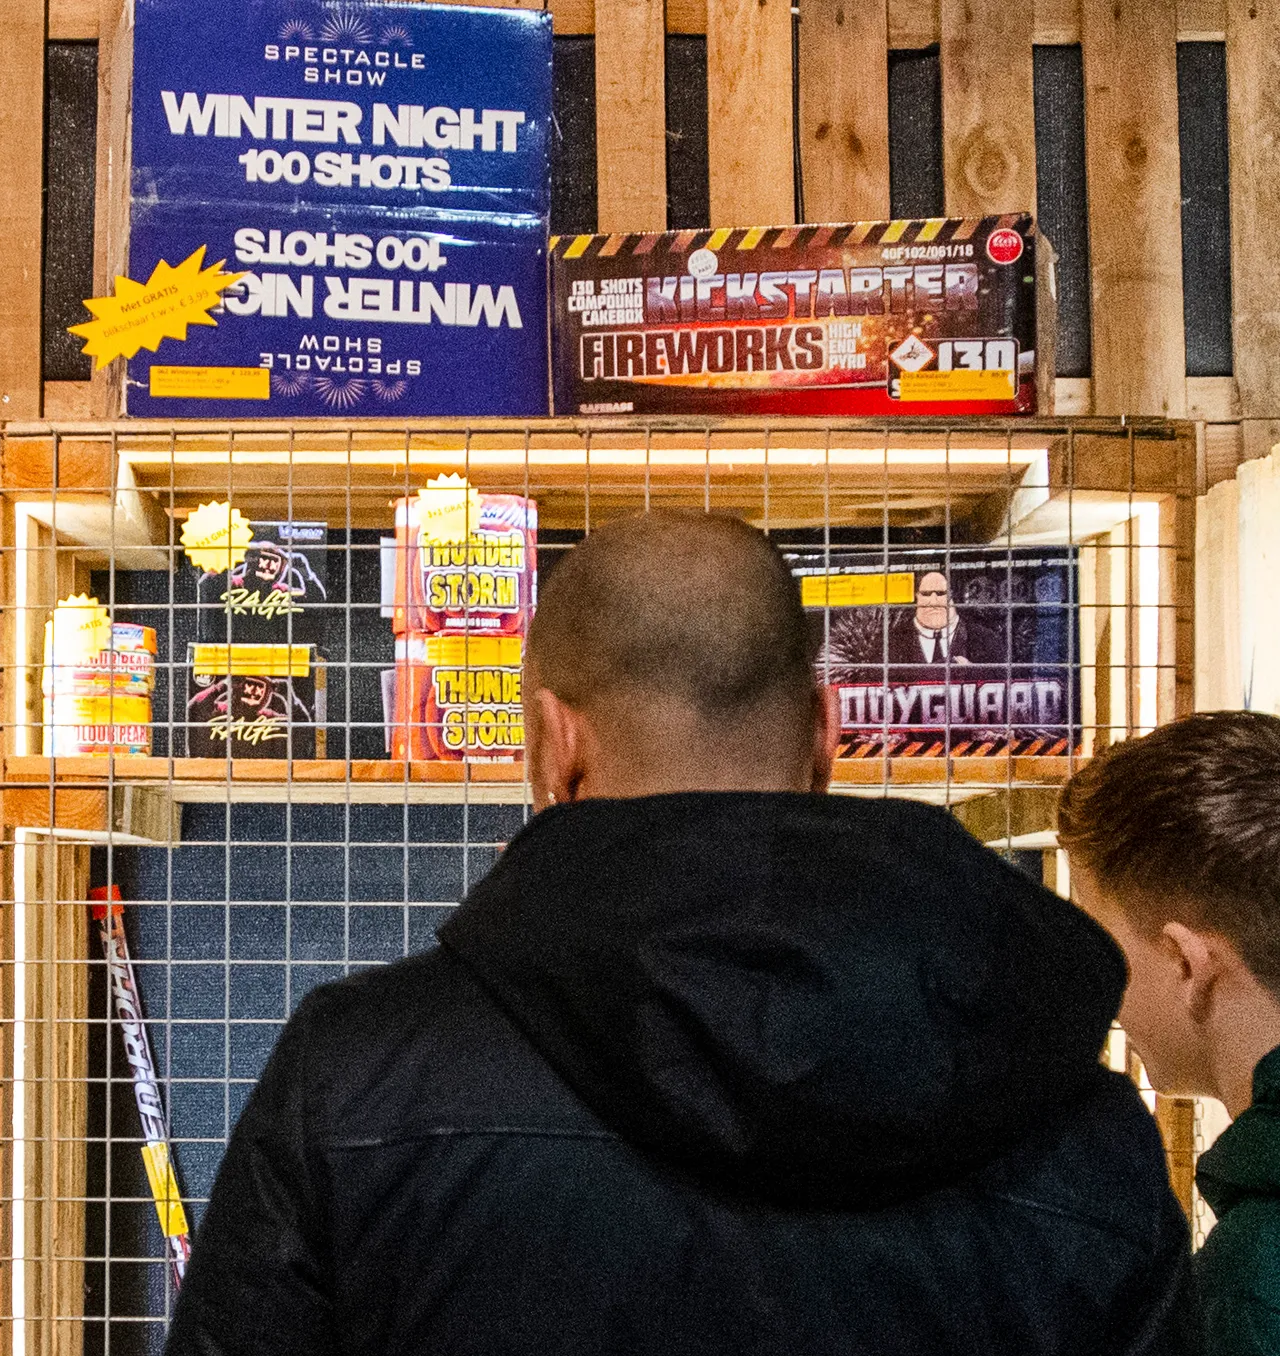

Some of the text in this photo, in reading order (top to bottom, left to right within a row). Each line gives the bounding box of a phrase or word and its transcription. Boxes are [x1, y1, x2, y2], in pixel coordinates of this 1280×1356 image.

[264, 45, 426, 69] SPECTACLE
[304, 67, 387, 86] SHOW
[160, 90, 525, 153] WINTER NIGHT
[238, 148, 452, 191] 100 SHOTS
[233, 228, 447, 272] 100 SHOTS
[120, 285, 179, 314] Met GRATIS
[214, 272, 523, 328] WINTER NIG
[572, 278, 643, 295] 130 SHOTS
[647, 263, 979, 323] KICKSTARTER
[568, 293, 644, 312] COMPOUND
[582, 308, 644, 325] CAKEBOX
[299, 335, 383, 352] SHOW
[829, 322, 862, 338] HIGH
[580, 323, 825, 380] FIREWORKS
[829, 338, 857, 353] END
[260, 353, 422, 375] SPECTACLE
[829, 353, 867, 369] PYRO
[422, 533, 524, 567] THUNDER
[431, 573, 517, 607] STORM
[436, 670, 522, 704] THUNDE
[837, 681, 1062, 726] ODYGUARD
[207, 714, 291, 746] RAGE
